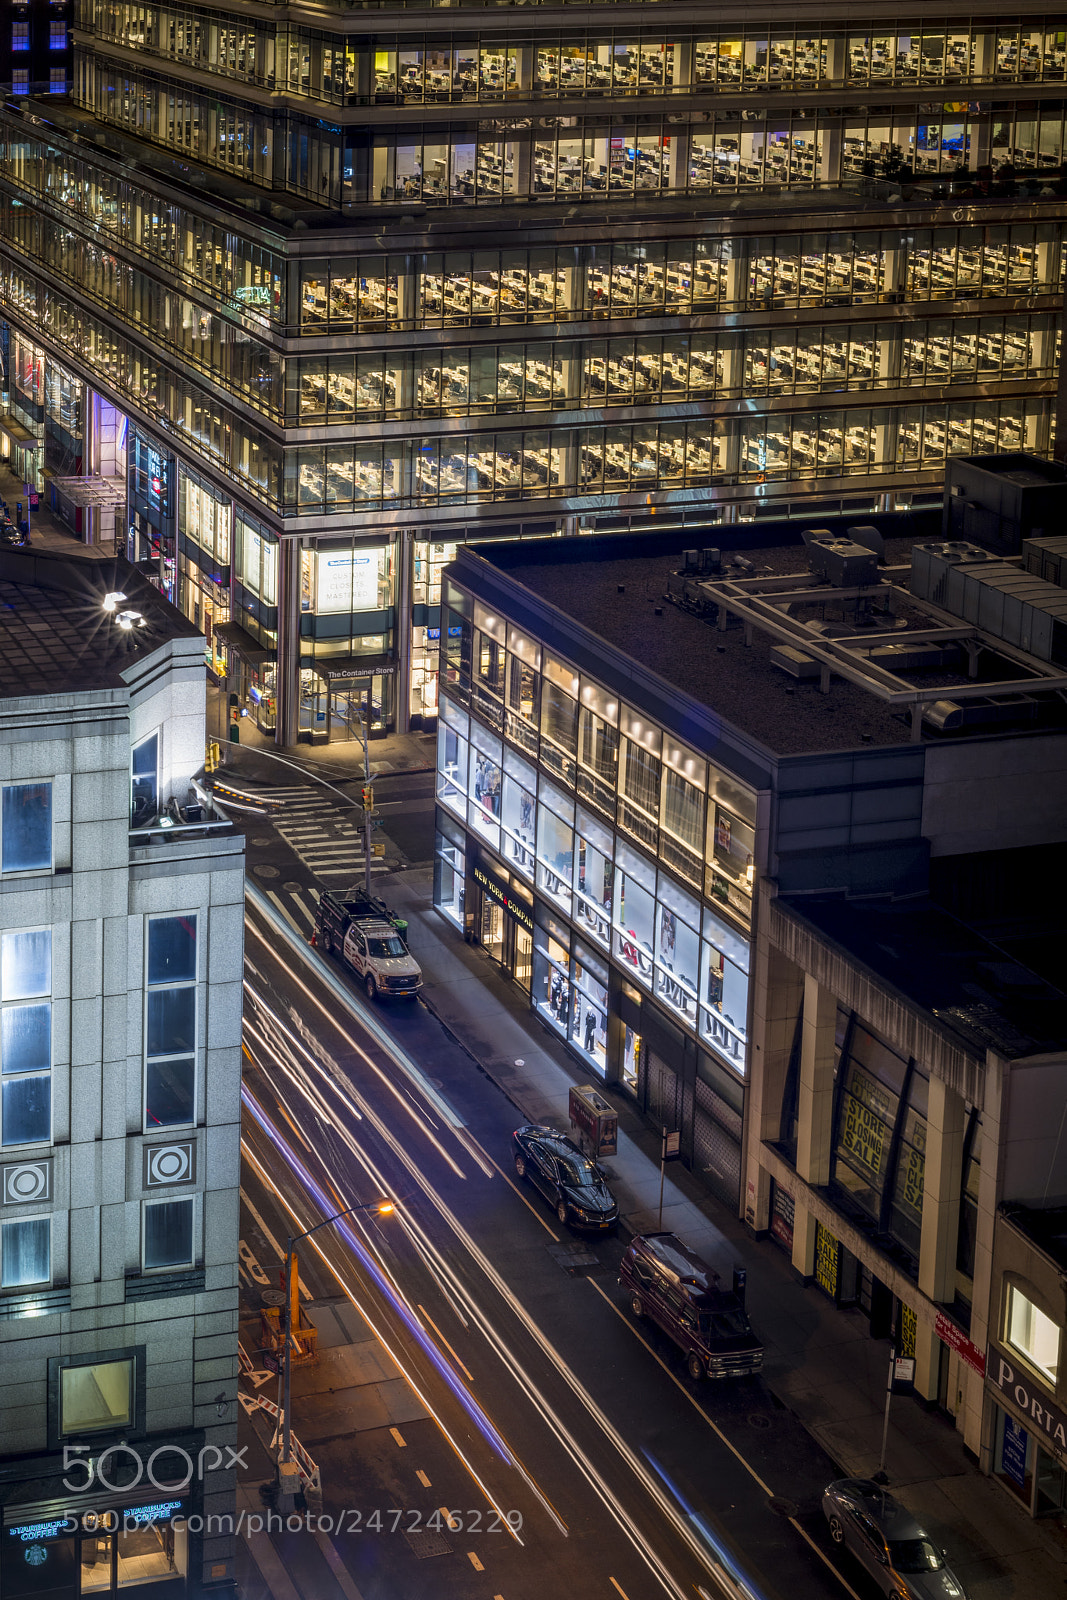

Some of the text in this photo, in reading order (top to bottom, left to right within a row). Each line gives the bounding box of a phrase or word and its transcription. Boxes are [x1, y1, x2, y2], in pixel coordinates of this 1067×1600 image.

[332, 571, 365, 582] CUSTM
[329, 581, 365, 590] CLOSTS
[341, 669, 375, 677] Container
[375, 667, 394, 675] Store
[474, 867, 488, 886] NEW
[488, 880, 504, 902] YORK
[507, 899, 534, 930] COMPAN
[849, 1097, 885, 1139] STORE
[846, 1115, 882, 1156] CLOSING
[844, 1131, 880, 1172] SALE
[944, 1326, 960, 1346] Lease
[951, 1325, 969, 1346] Space
[124, 1501, 182, 1517] STARBUCKS
[134, 1510, 171, 1522] COFFEE
[9, 1519, 69, 1536] STARBUCKS
[20, 1528, 58, 1541] COFFEE
